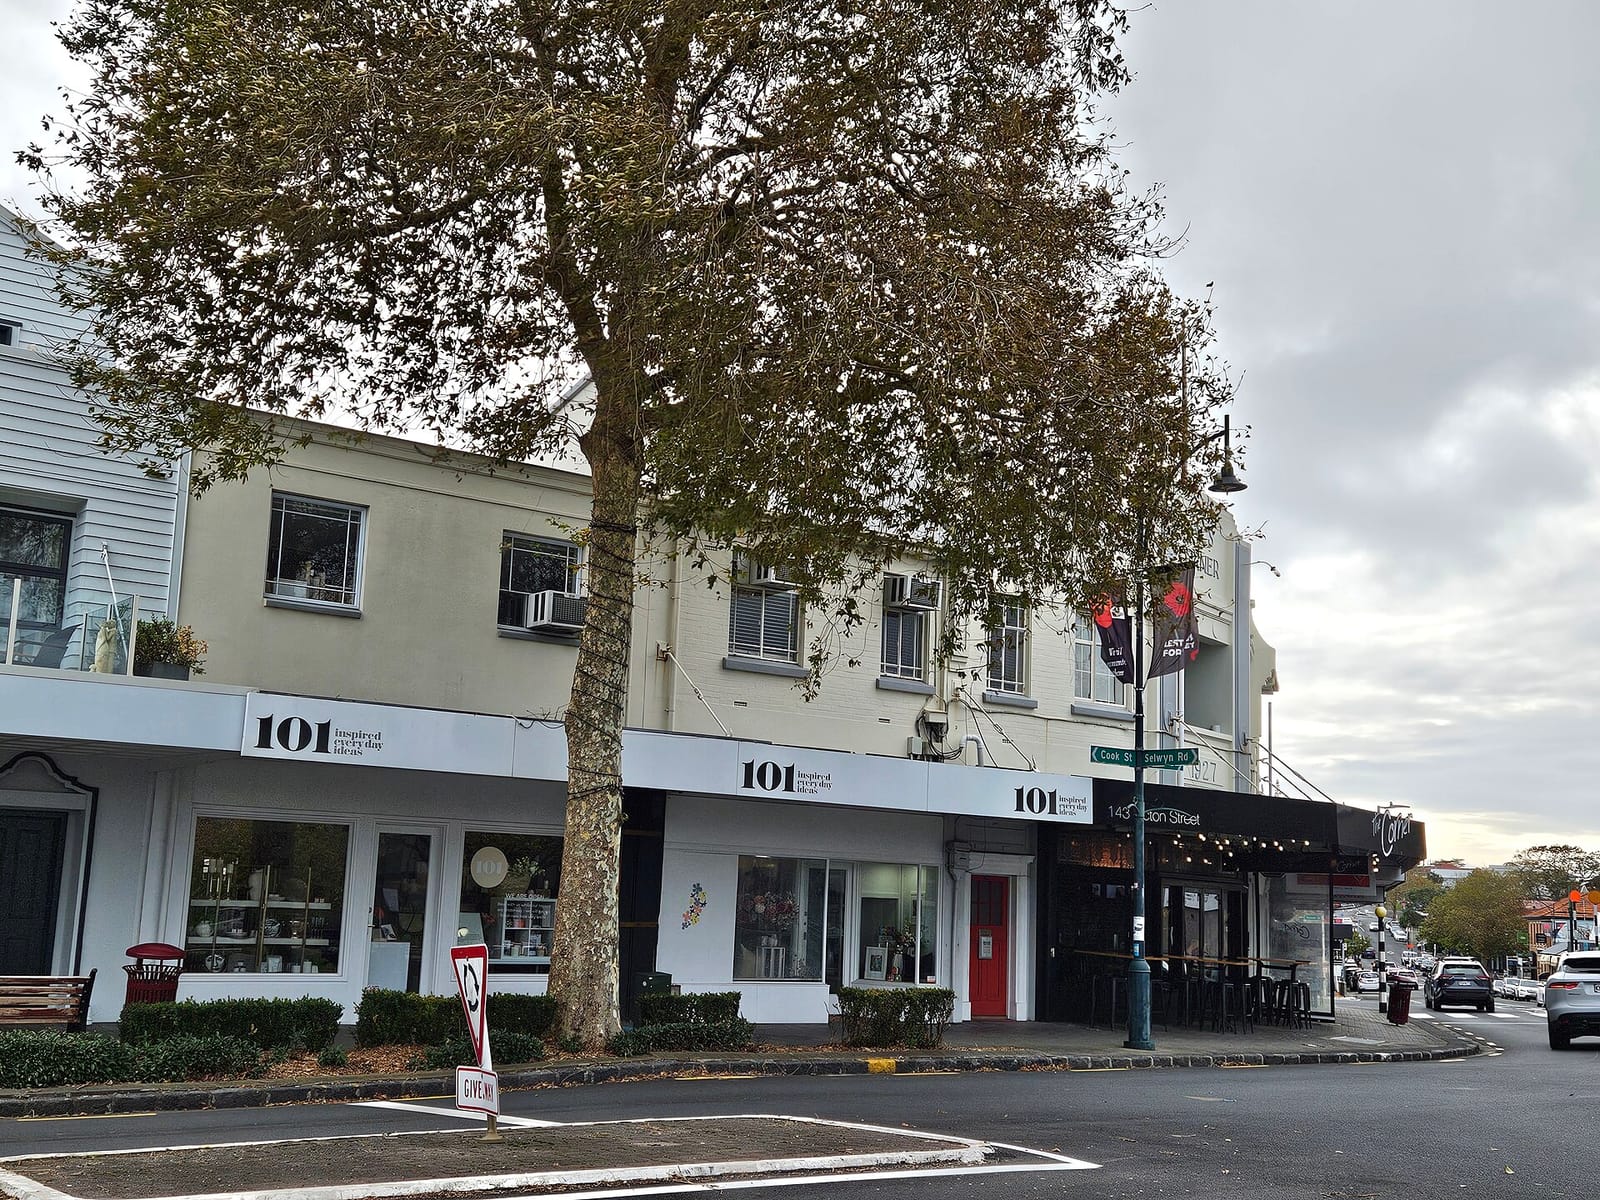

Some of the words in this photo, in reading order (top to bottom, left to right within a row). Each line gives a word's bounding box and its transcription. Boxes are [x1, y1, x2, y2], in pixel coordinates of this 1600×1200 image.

[253, 713, 332, 754] 101
[334, 727, 382, 742] inspired
[333, 745, 364, 756] ideas
[1100, 749, 1120, 761] Cook
[1123, 751, 1133, 762] St
[1144, 752, 1175, 766] Selwyn
[1177, 751, 1189, 762] Rd
[741, 758, 797, 793] 101
[797, 770, 832, 782] inspired
[1190, 760, 1217, 783] 1927
[797, 784, 819, 794] ideas
[1014, 785, 1058, 816] 101
[1059, 795, 1087, 805] inspired
[1108, 805, 1131, 820] 143
[1143, 810, 1167, 823] cton
[1169, 811, 1201, 826] Street
[1381, 809, 1413, 857] Corner
[464, 1078, 482, 1100] GIVE
